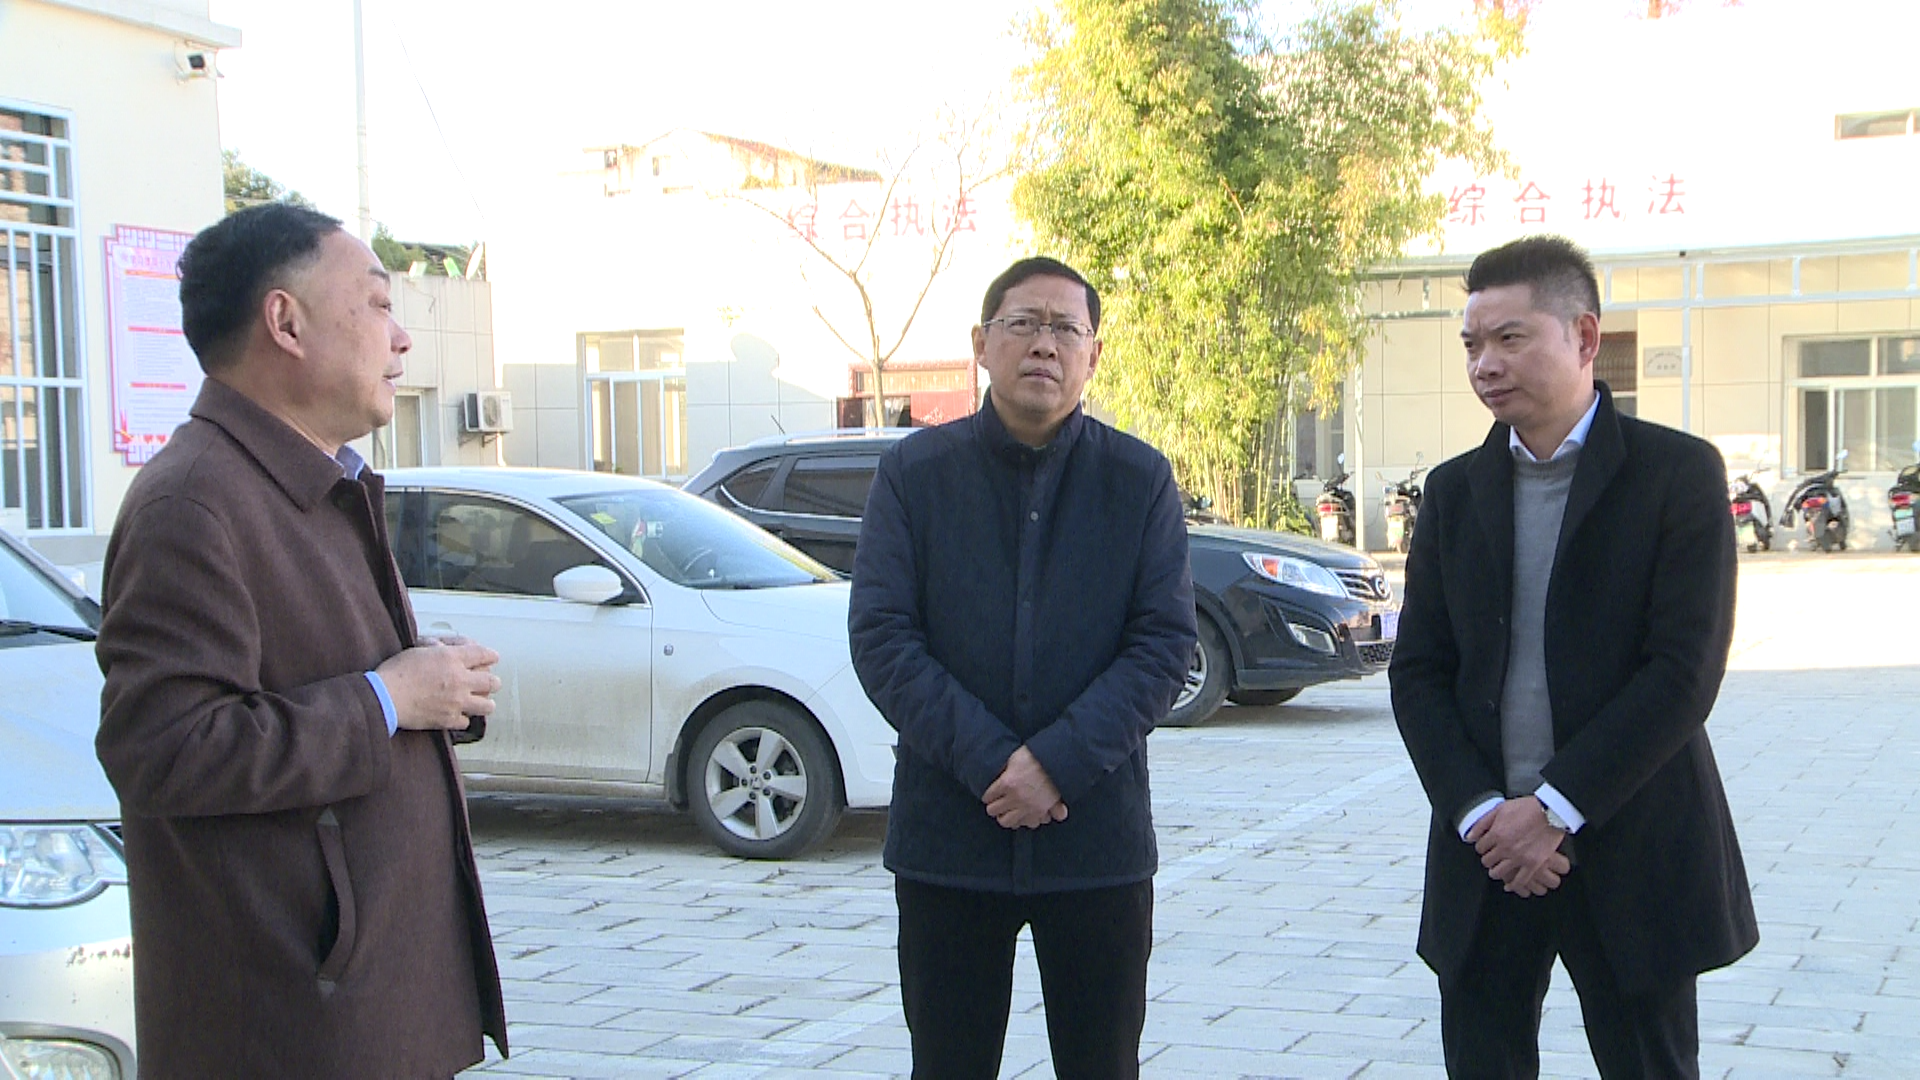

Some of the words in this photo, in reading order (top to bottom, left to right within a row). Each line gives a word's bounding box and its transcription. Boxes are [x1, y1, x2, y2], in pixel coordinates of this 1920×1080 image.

[787, 191, 977, 242] 综合执法
[1447, 173, 1686, 226] 综合执法
